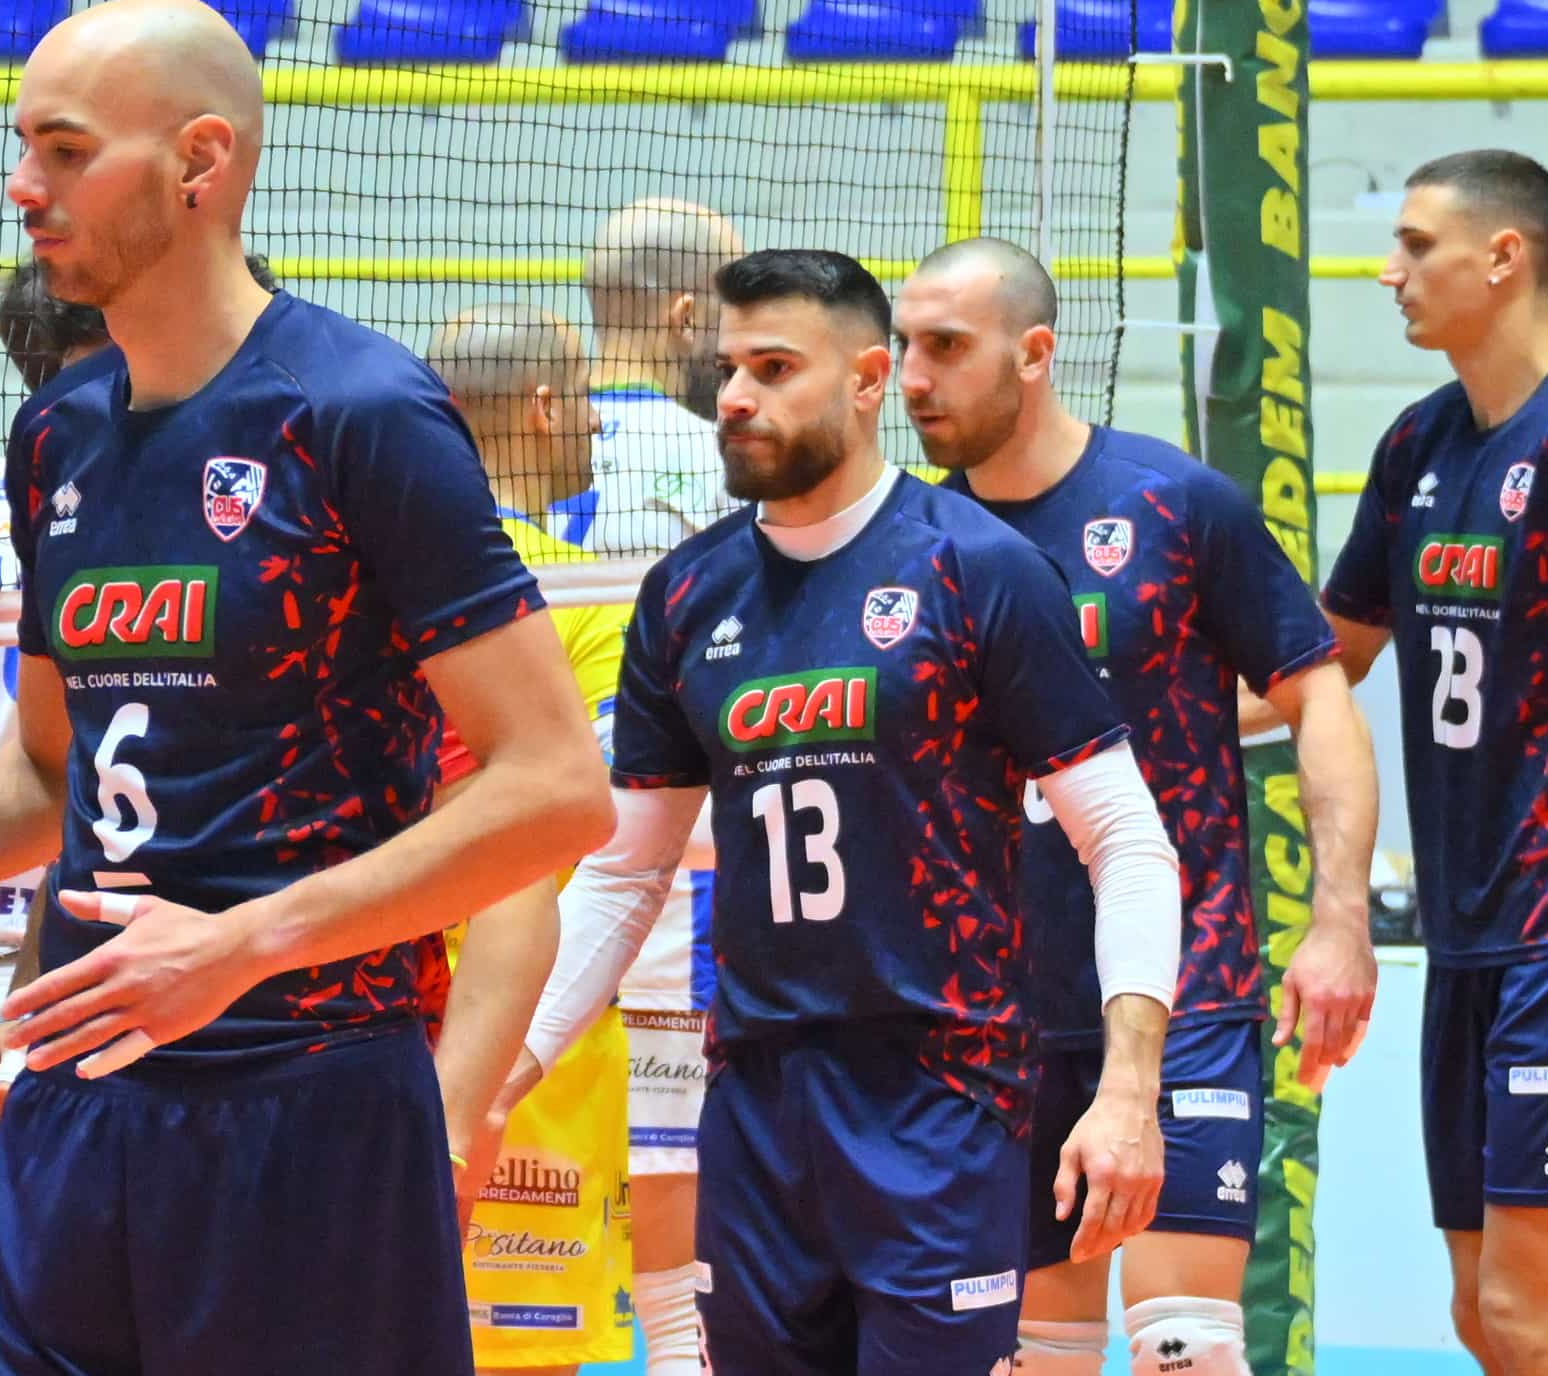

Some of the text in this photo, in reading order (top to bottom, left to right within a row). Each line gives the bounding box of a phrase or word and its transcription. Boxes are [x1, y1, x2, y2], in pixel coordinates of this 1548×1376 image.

[1259, 305, 1312, 584] EDEM
[1419, 542, 1497, 588] CRAI
[58, 579, 207, 649] CRAI
[66, 671, 217, 689] NEL CUORE DELL'ITALIA
[727, 677, 866, 742] CRAI
[92, 702, 158, 864] 6
[757, 756, 792, 774] CUORE
[794, 751, 875, 769] DELL'ITALIA
[752, 778, 847, 924] 13
[478, 1186, 578, 1205] RREDAMENTI
[490, 1156, 580, 1190] ellino
